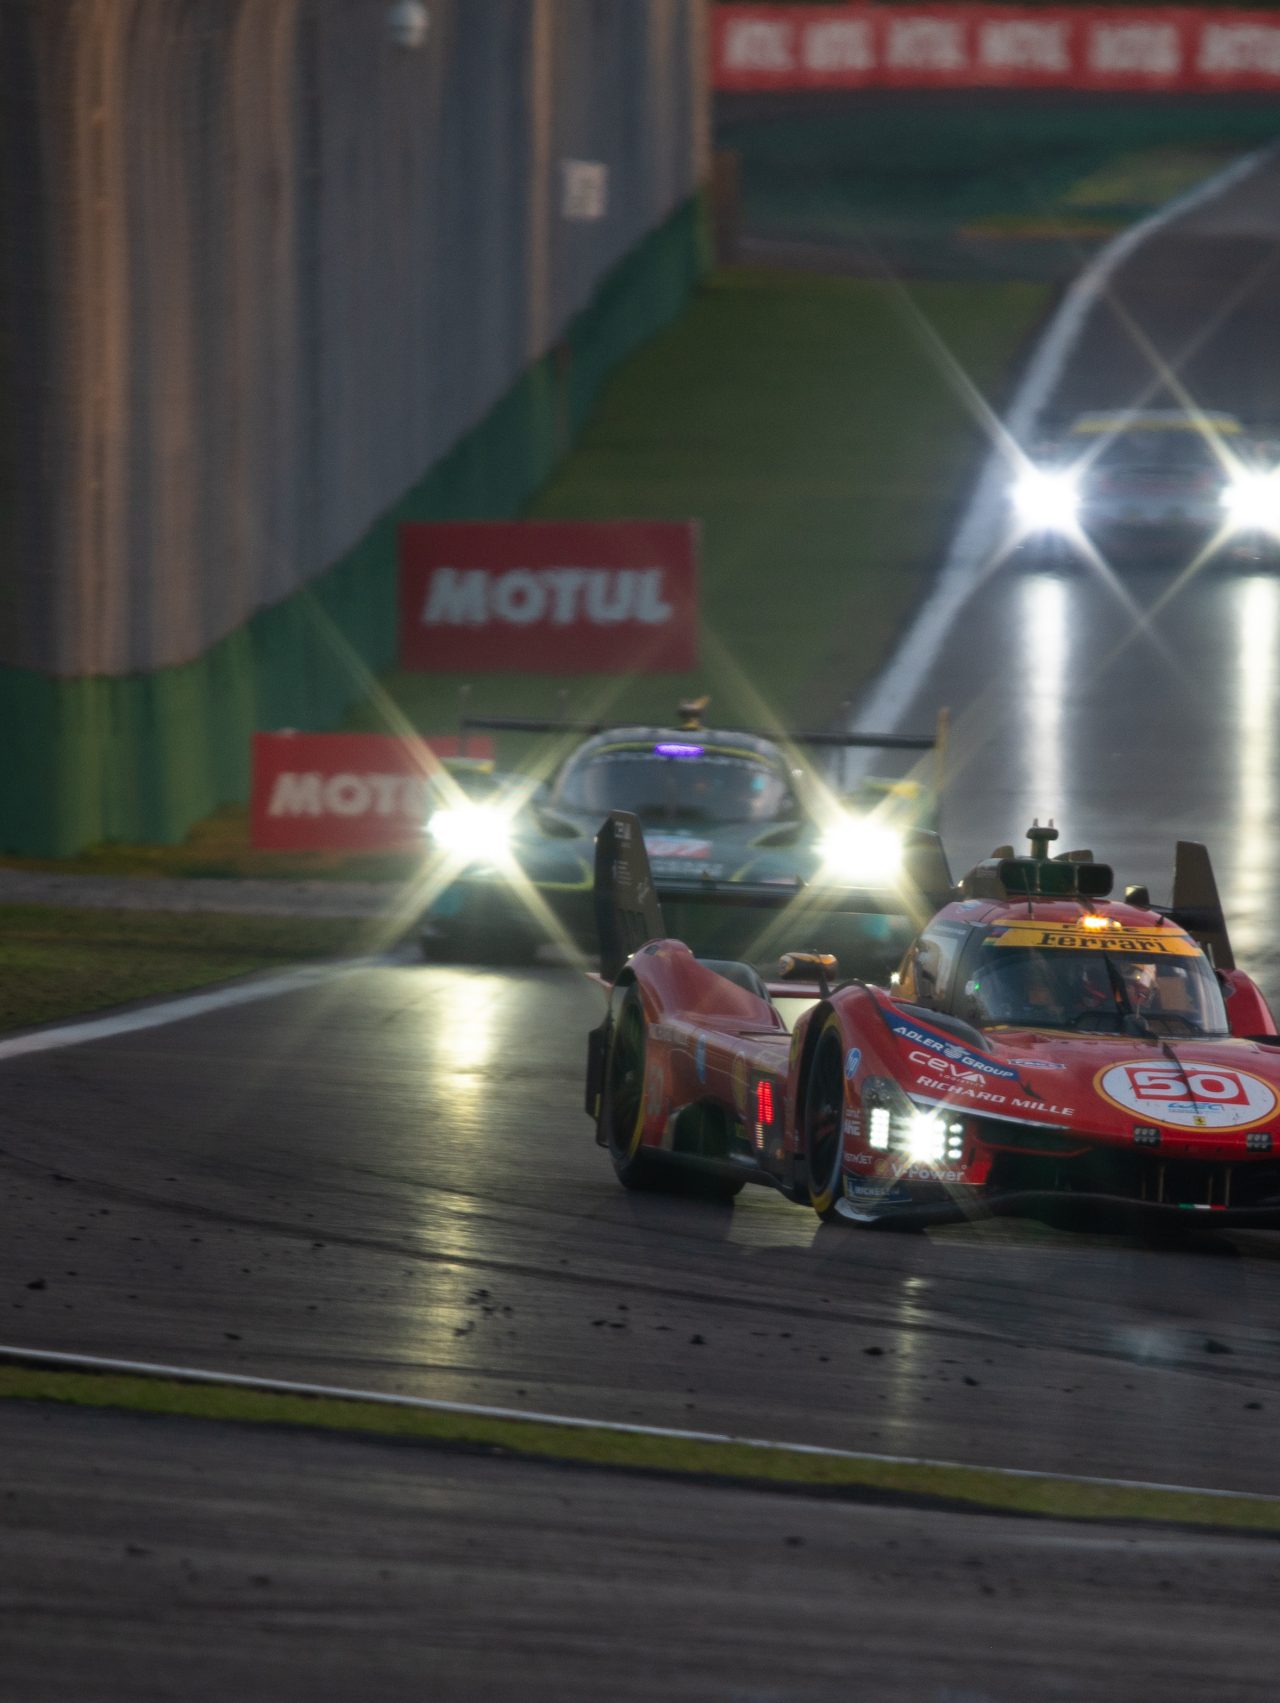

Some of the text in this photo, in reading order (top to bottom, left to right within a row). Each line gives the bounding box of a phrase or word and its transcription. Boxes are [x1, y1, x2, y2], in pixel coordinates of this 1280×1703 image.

[422, 568, 672, 625] MOTUL
[269, 773, 431, 816] MOT
[1036, 932, 1168, 952] Ferrari
[893, 1026, 944, 1051] ADLER
[961, 1055, 1015, 1078] GROUP
[916, 1075, 1075, 1116] RICHARD MILLE
[1133, 1071, 1239, 1099] 50
[891, 1163, 965, 1181] V-Power
